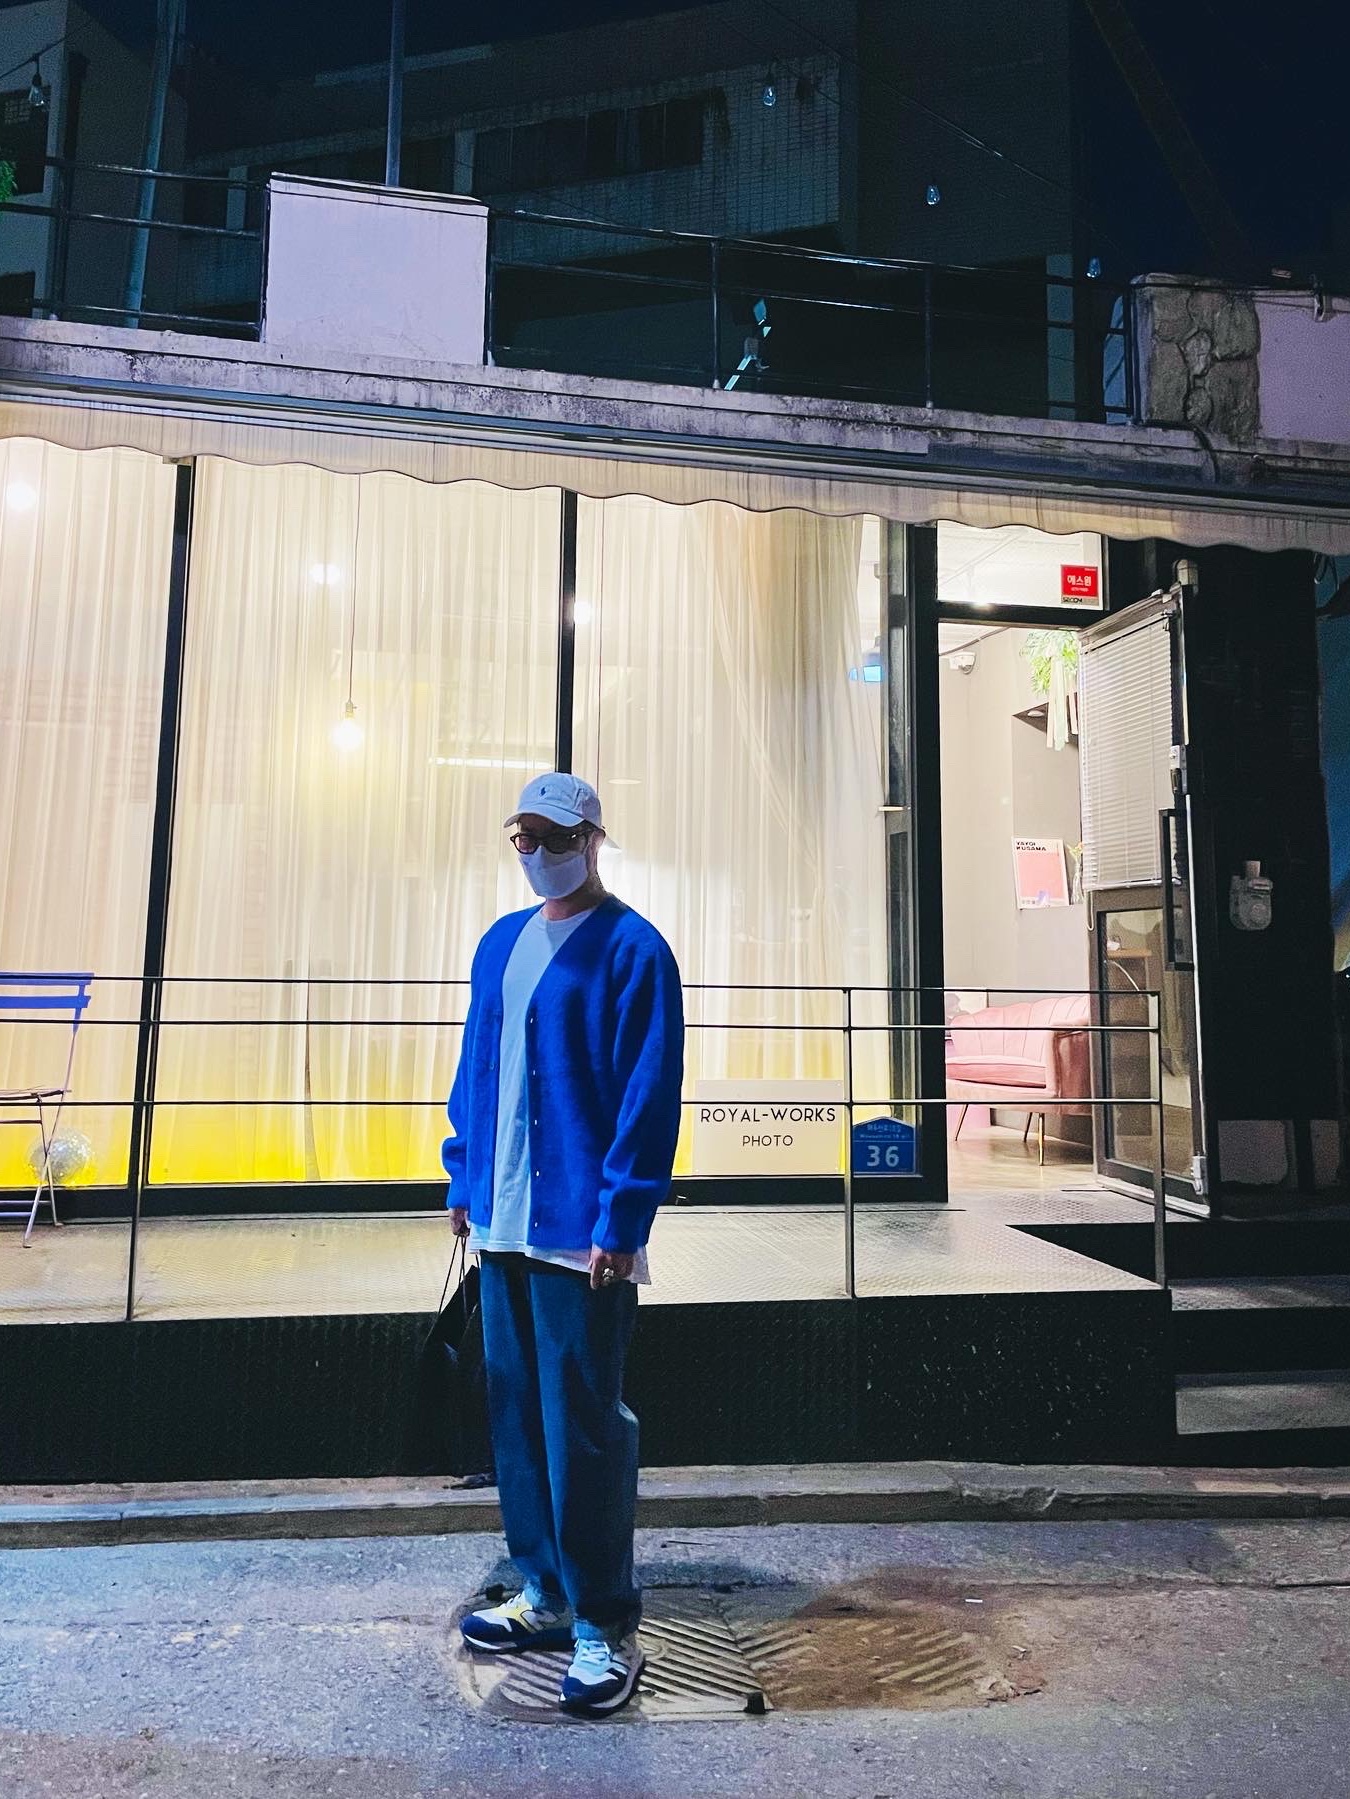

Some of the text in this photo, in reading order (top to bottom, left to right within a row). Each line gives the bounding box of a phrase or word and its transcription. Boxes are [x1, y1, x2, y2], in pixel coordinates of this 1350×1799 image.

[1067, 575, 1092, 586] 에스원
[700, 1108, 836, 1122] ROYAL-WORKS
[742, 1135, 794, 1147] PHOTO
[867, 1145, 900, 1168] 36
